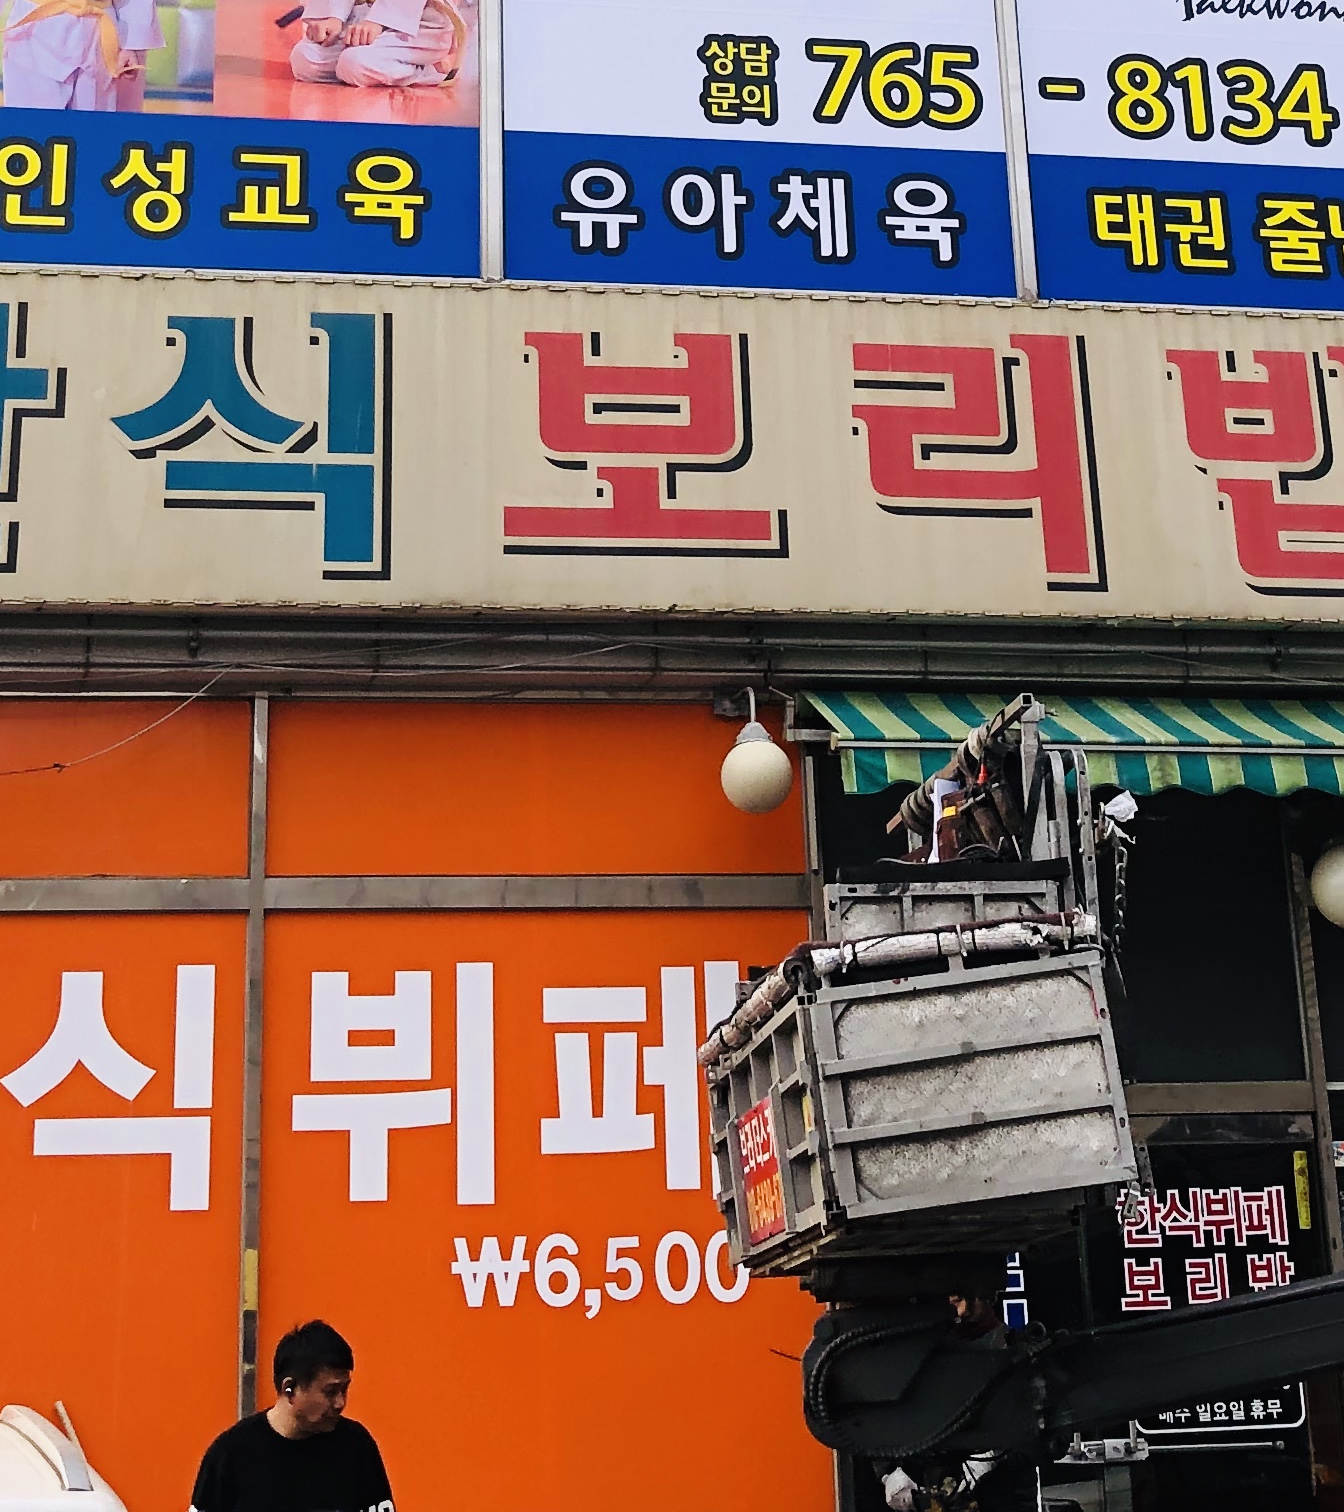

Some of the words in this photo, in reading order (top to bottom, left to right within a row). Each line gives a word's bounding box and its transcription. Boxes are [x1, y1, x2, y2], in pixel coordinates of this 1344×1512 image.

[701, 37, 774, 78] 상담
[704, 81, 775, 121] 문의
[558, 164, 963, 265] 유아체육
[1090, 190, 1232, 272] 태권
[1115, 1186, 1290, 1248] 한식뷔페
[1196, 1399, 1246, 1422] 일요일
[1250, 1398, 1283, 1420] 휴무
